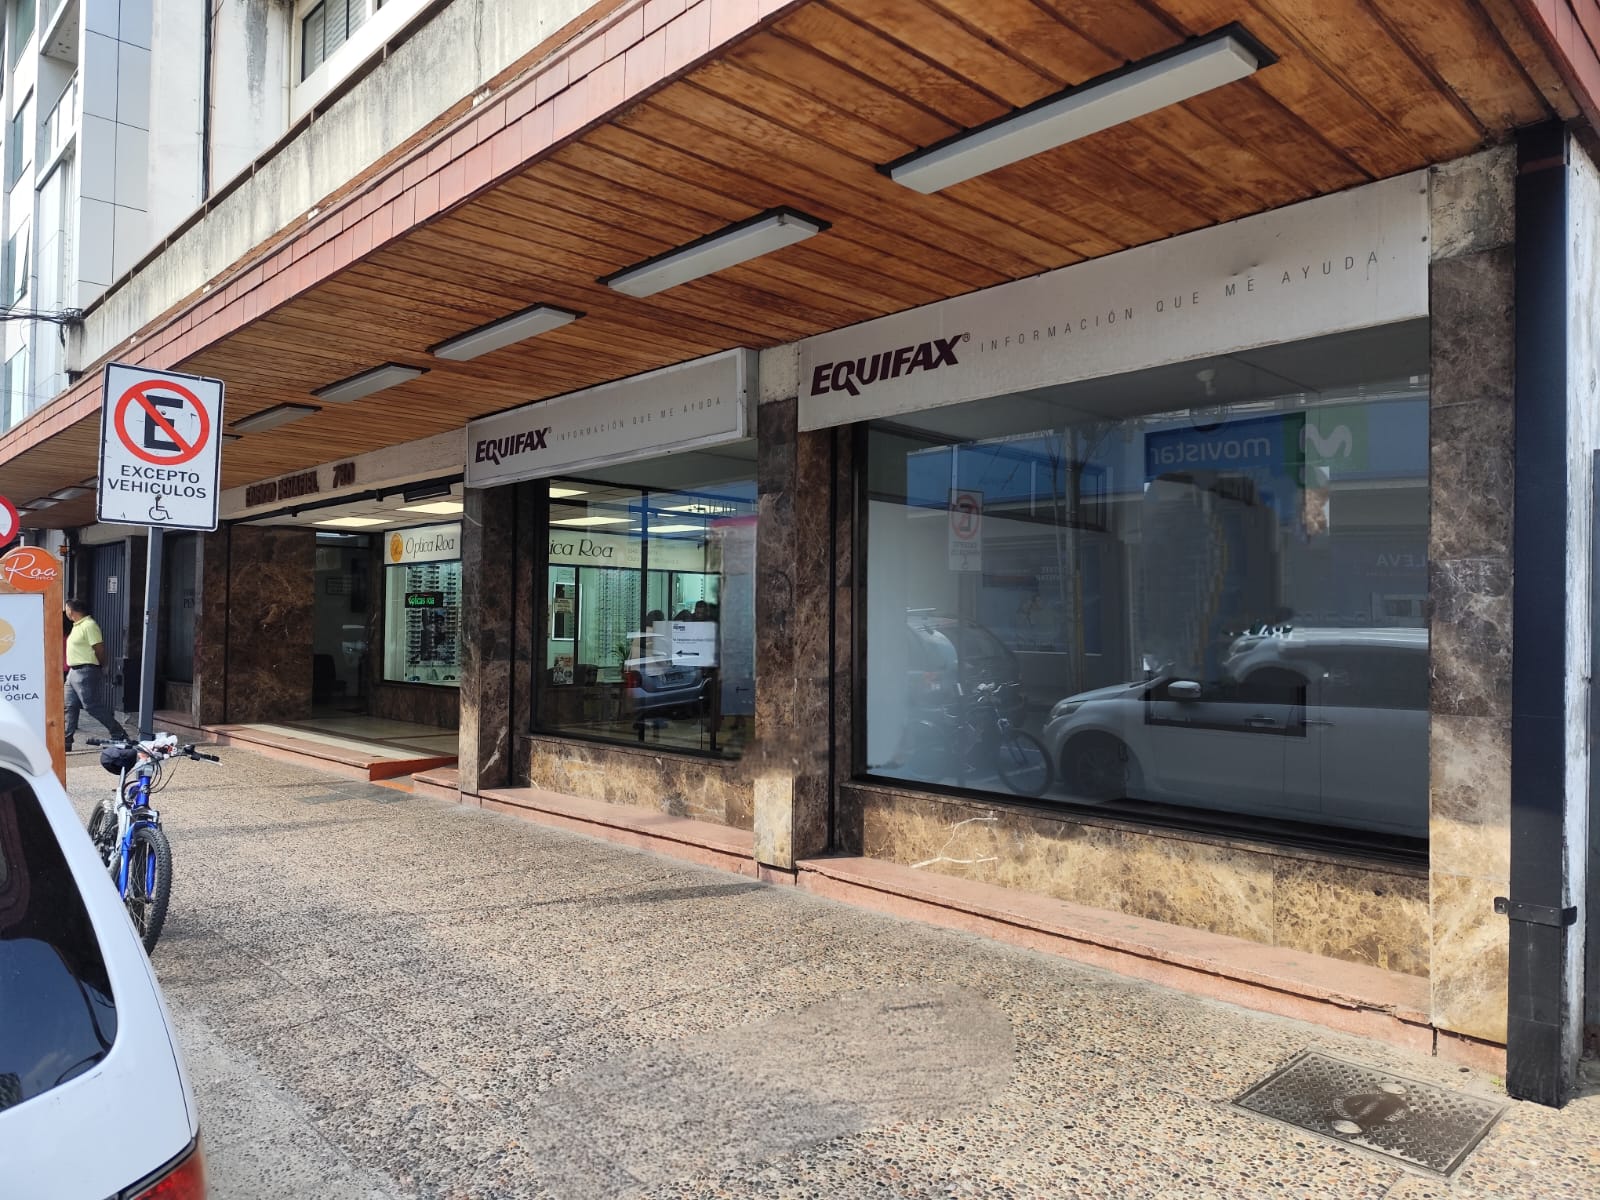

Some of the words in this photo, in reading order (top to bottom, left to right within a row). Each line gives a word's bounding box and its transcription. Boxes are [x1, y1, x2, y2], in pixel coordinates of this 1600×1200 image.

[980, 307, 1133, 353] INFORMACIÓN
[1156, 291, 1200, 313] QUE
[1225, 278, 1255, 297] ME
[121, 464, 200, 484] EXCEPTO
[107, 478, 207, 499] VEHICULOS
[436, 534, 455, 552] Roa
[578, 538, 614, 558] Roa
[5, 552, 58, 584] Roa
